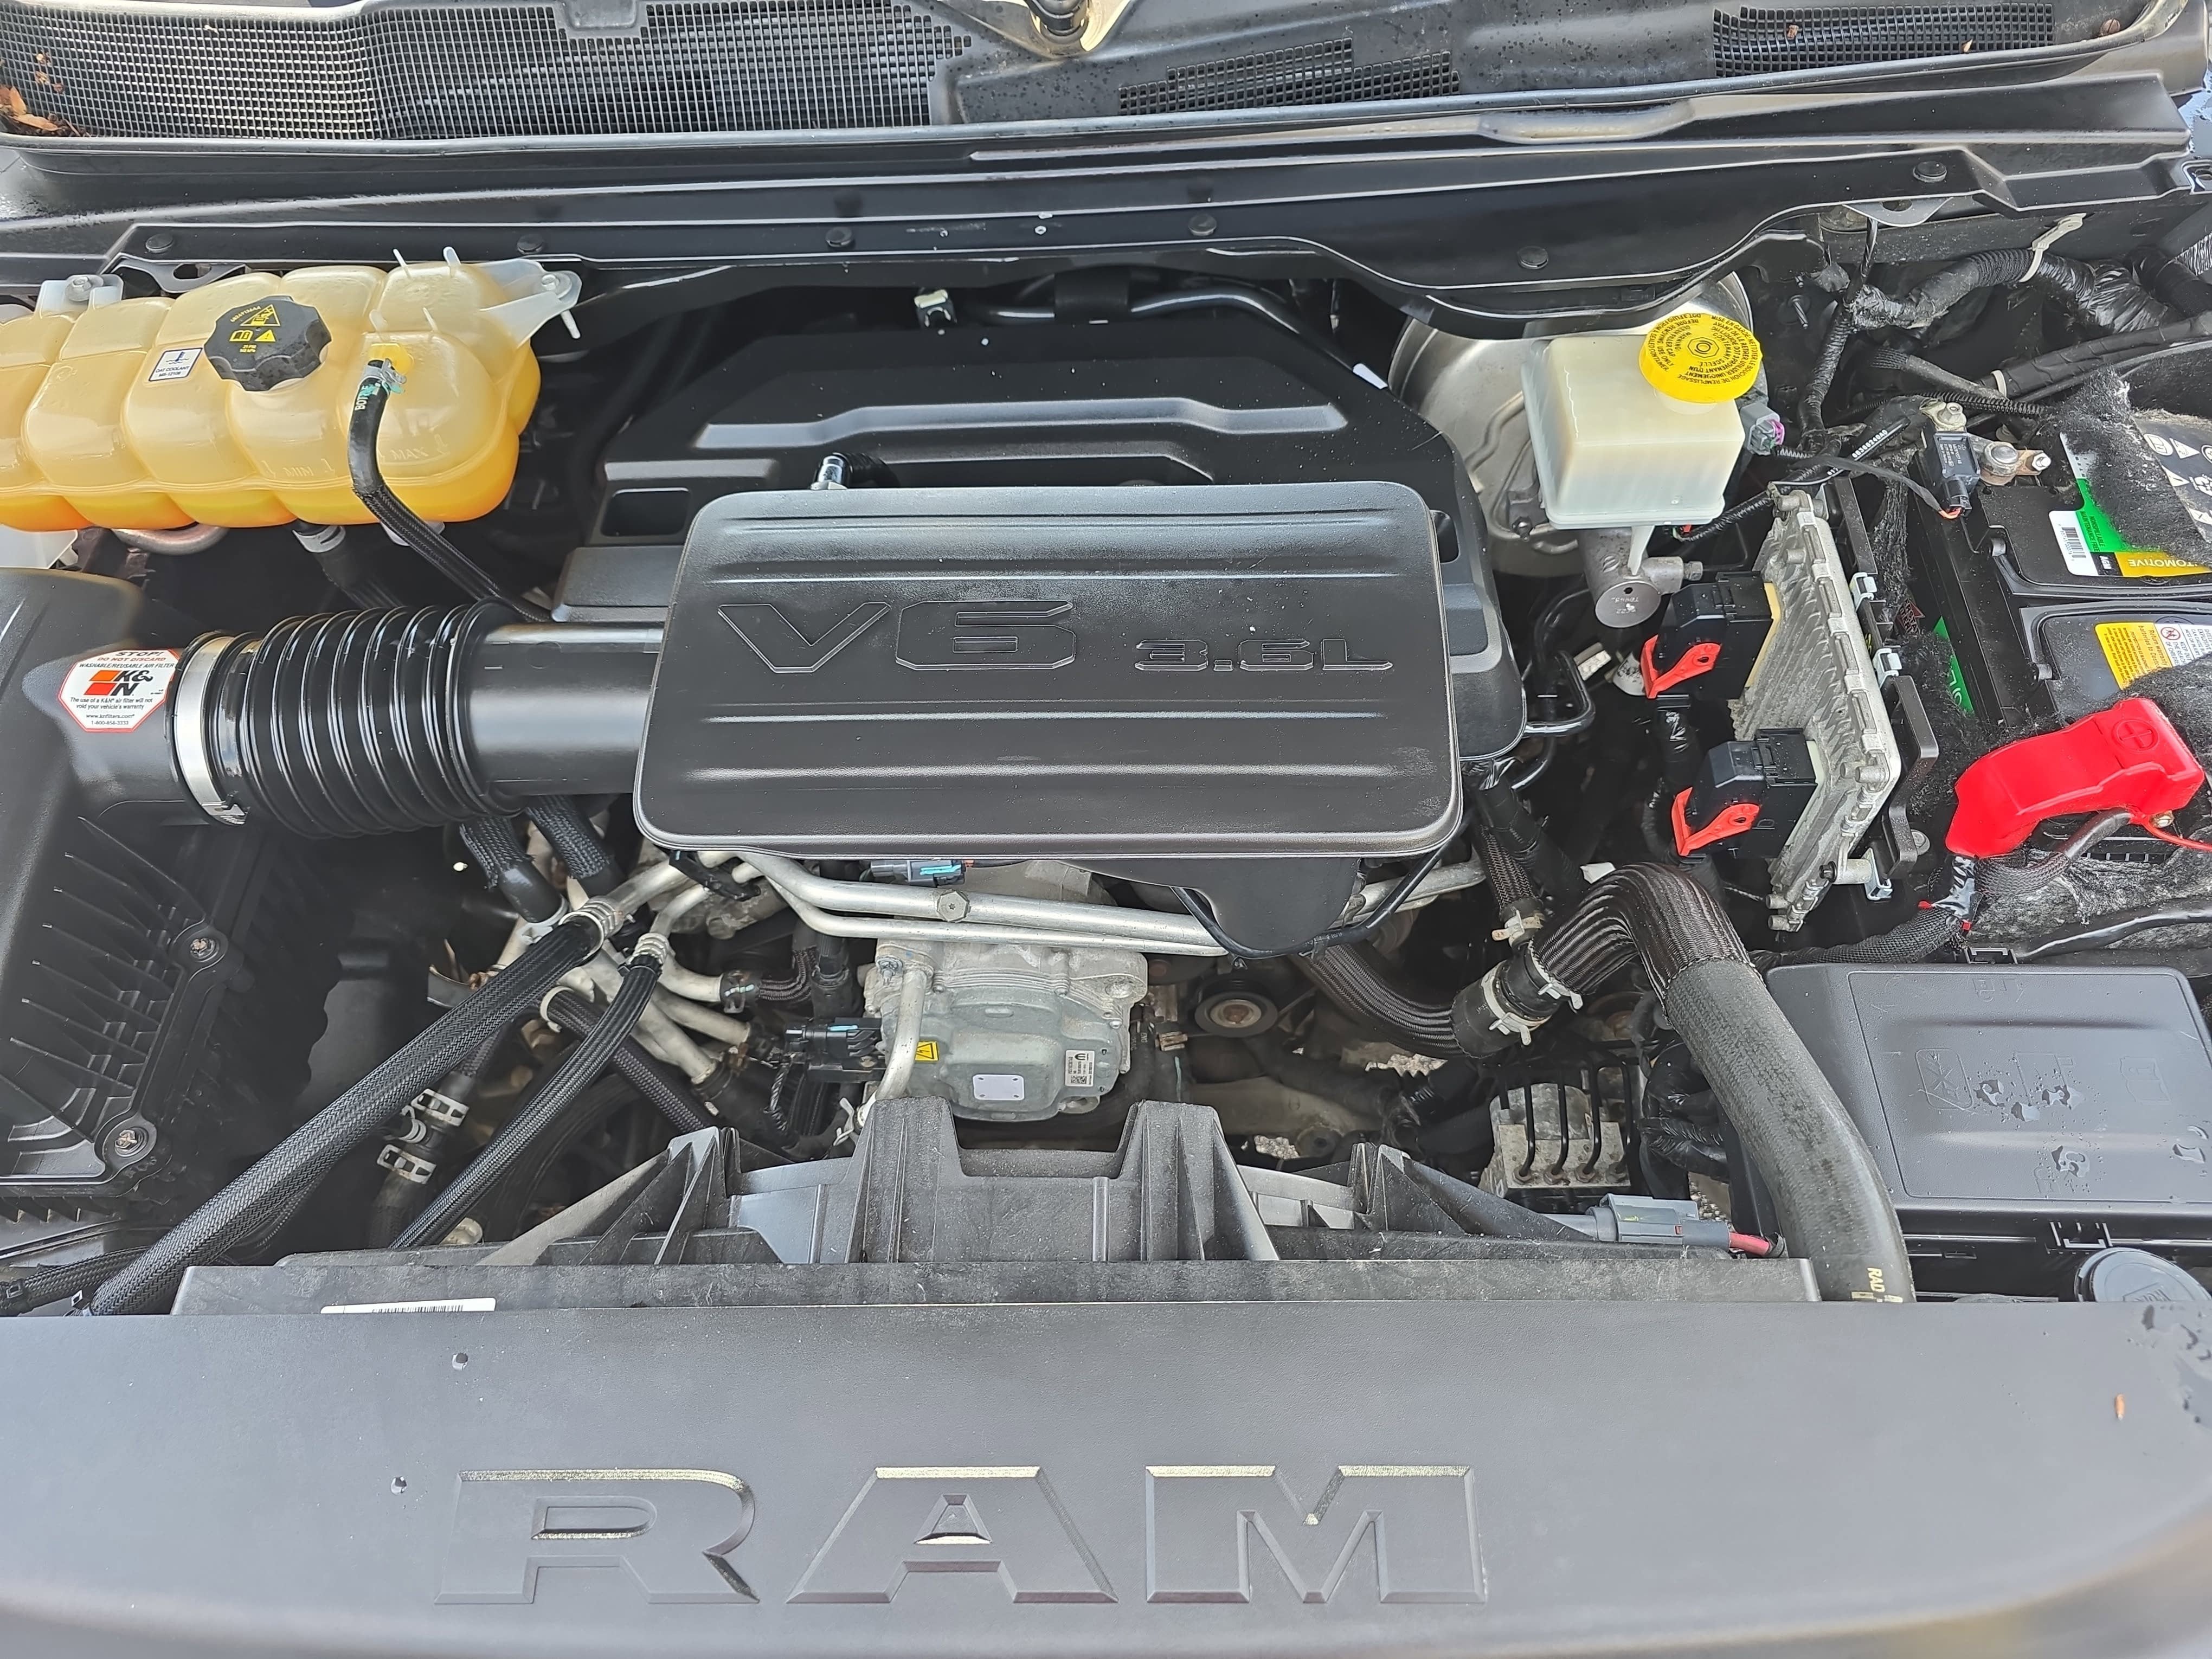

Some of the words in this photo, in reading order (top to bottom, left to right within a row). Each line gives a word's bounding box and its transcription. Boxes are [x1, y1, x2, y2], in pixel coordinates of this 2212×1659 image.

[1713, 321, 1733, 331] AVANT
[1705, 358, 1738, 373] PROVENANT
[1677, 374, 1721, 384] REMPLISSAGE
[390, 446, 430, 460] MAX
[2080, 511, 2095, 541] MAINTENANCE
[2091, 541, 2100, 552] FREE
[2090, 516, 2105, 547] NONSPILLABLE
[2099, 555, 2112, 570] AGM
[718, 600, 1076, 673] V6
[1135, 638, 1393, 671] 3.6L
[2138, 625, 2151, 646] batteries
[2179, 641, 2188, 651] KEEP
[2148, 630, 2158, 645] Return
[2156, 646, 2169, 666] warranty
[1867, 1268, 1886, 1293] RAD
[433, 1465, 1488, 1606] RAM
